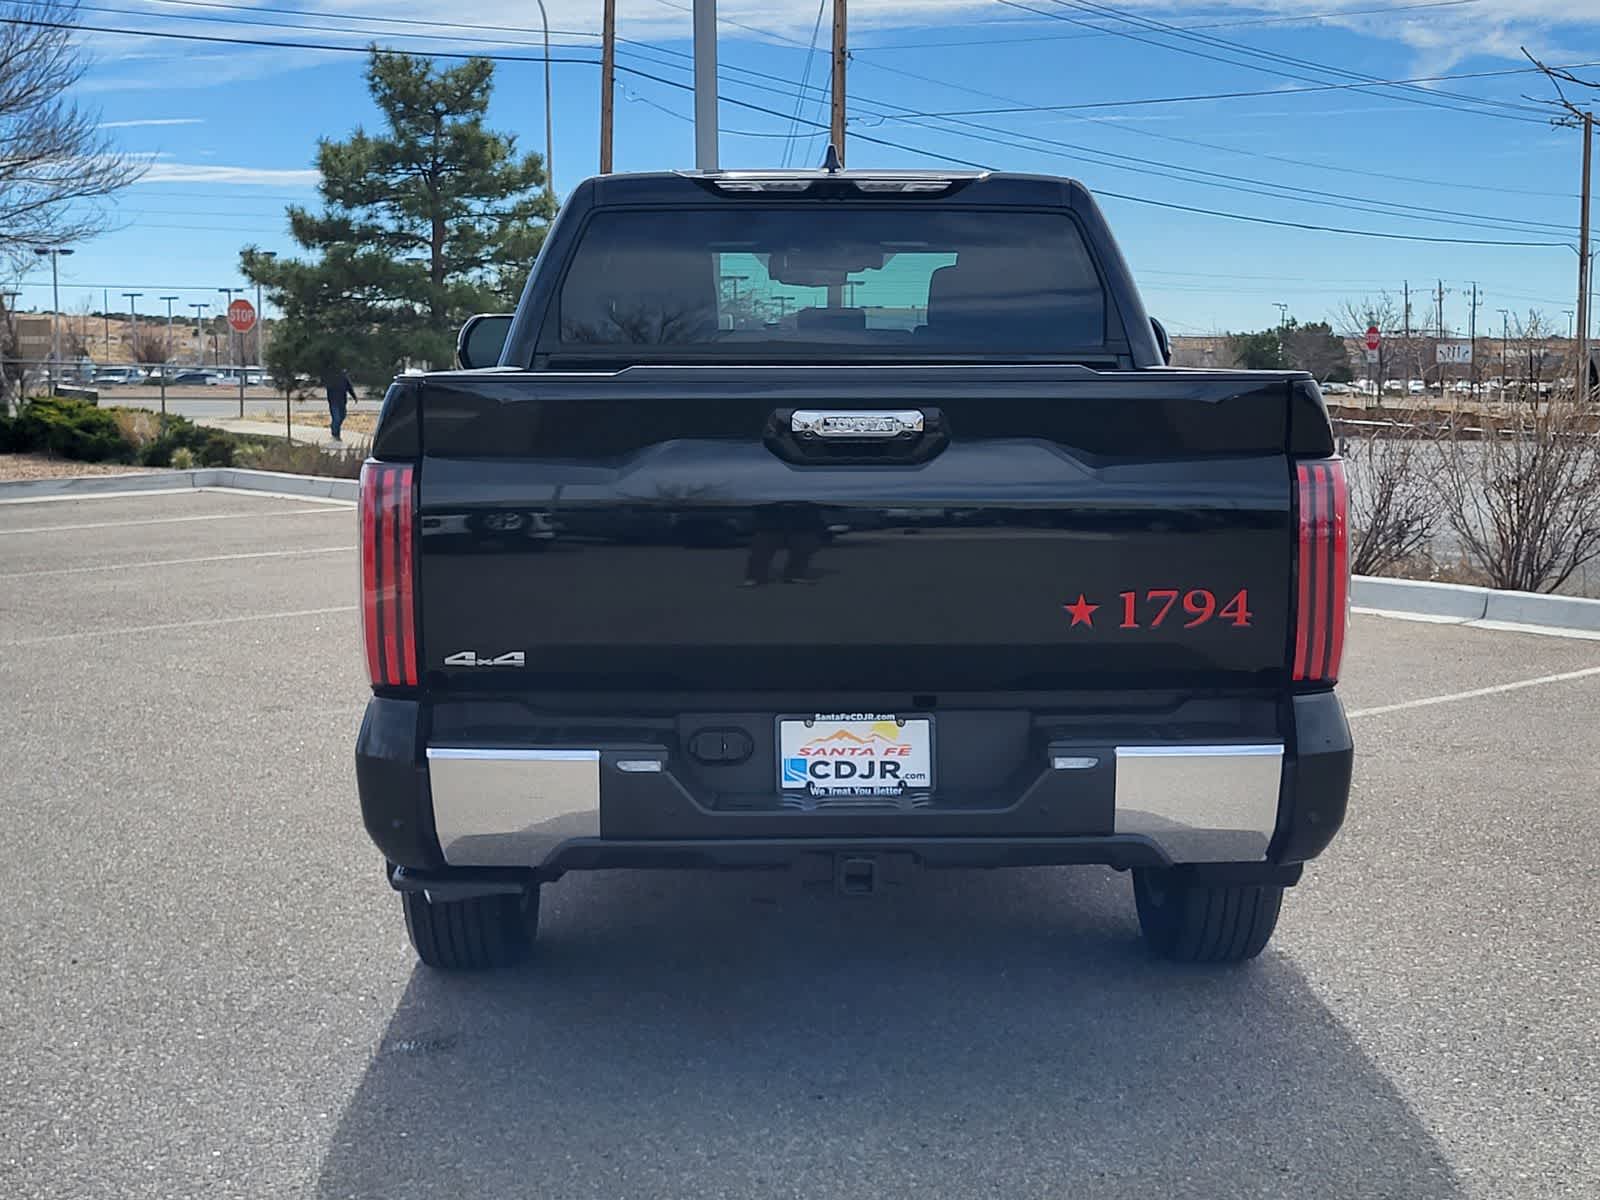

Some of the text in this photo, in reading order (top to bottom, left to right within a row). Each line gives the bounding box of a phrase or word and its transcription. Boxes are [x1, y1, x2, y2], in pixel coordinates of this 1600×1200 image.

[230, 308, 254, 322] STOP
[1119, 588, 1253, 629] 1794
[815, 713, 896, 721] SantaFeCDJR.com
[798, 744, 912, 757] SANTA FE
[810, 783, 903, 796] We Treat You Better
